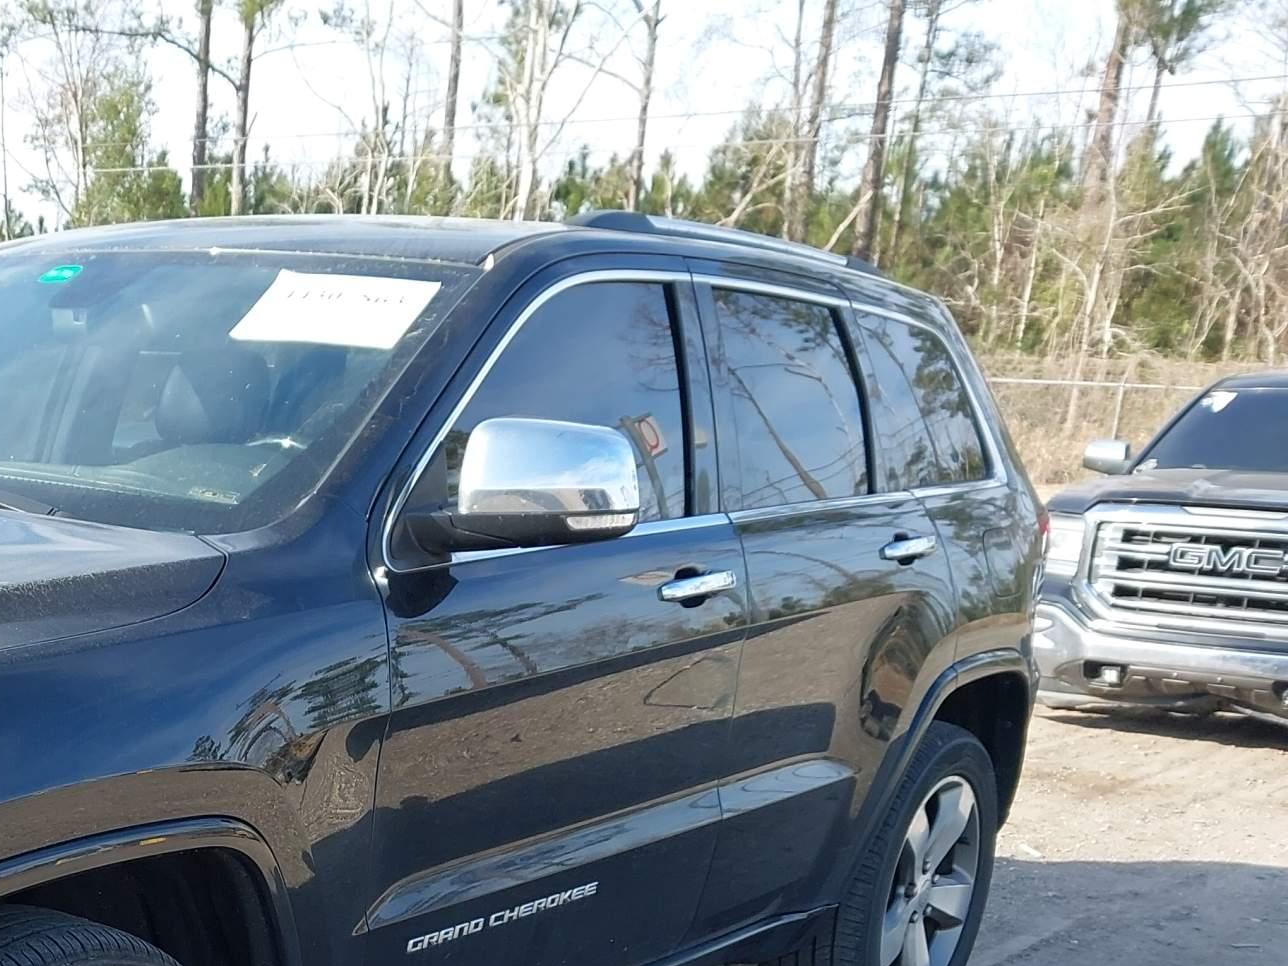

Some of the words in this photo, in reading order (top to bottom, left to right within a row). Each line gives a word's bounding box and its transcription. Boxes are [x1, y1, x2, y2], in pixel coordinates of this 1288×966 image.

[1169, 542, 1283, 575] GMC
[406, 917, 485, 953] GRAND
[488, 881, 599, 927] CHEROKEE
